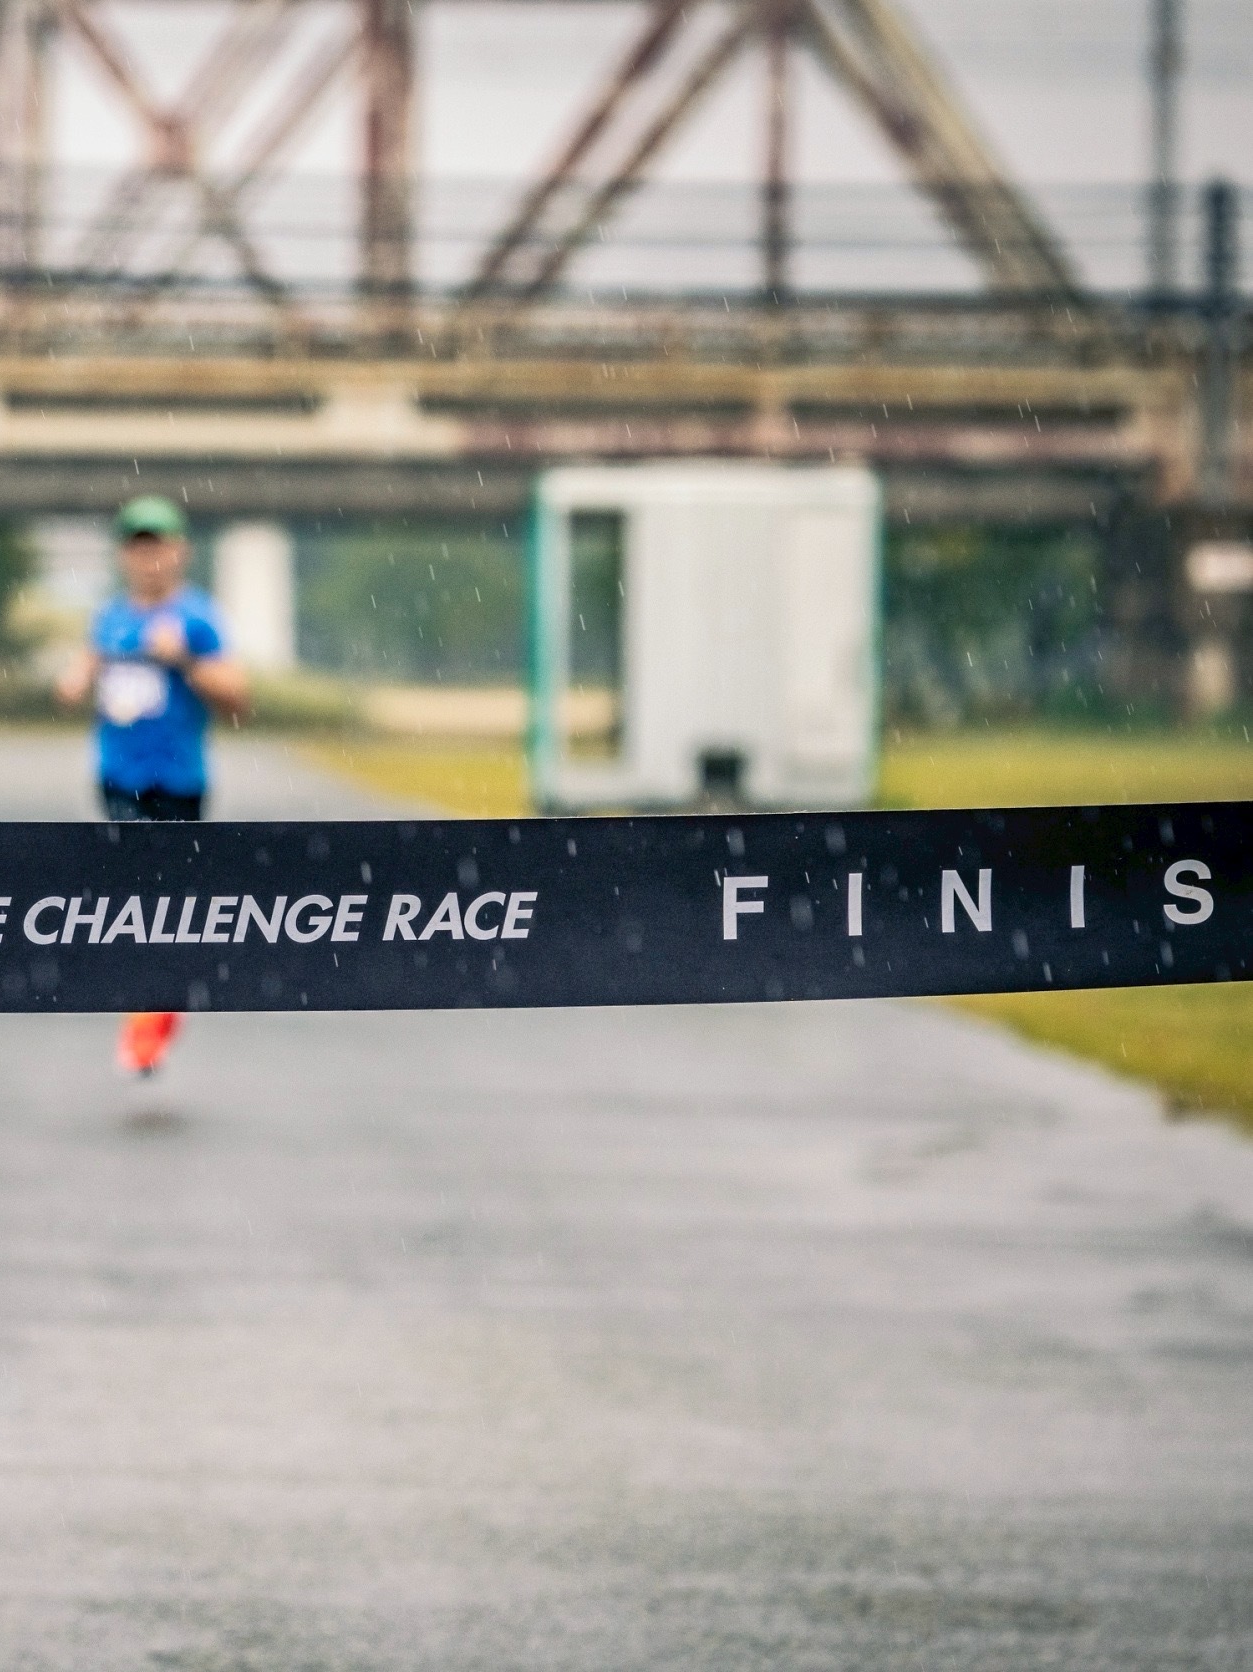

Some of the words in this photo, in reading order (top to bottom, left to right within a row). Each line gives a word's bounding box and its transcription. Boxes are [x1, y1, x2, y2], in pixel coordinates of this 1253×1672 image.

[23, 894, 369, 945] CHALLENGE
[382, 891, 538, 942] RACE
[722, 859, 1215, 940] FINIS
